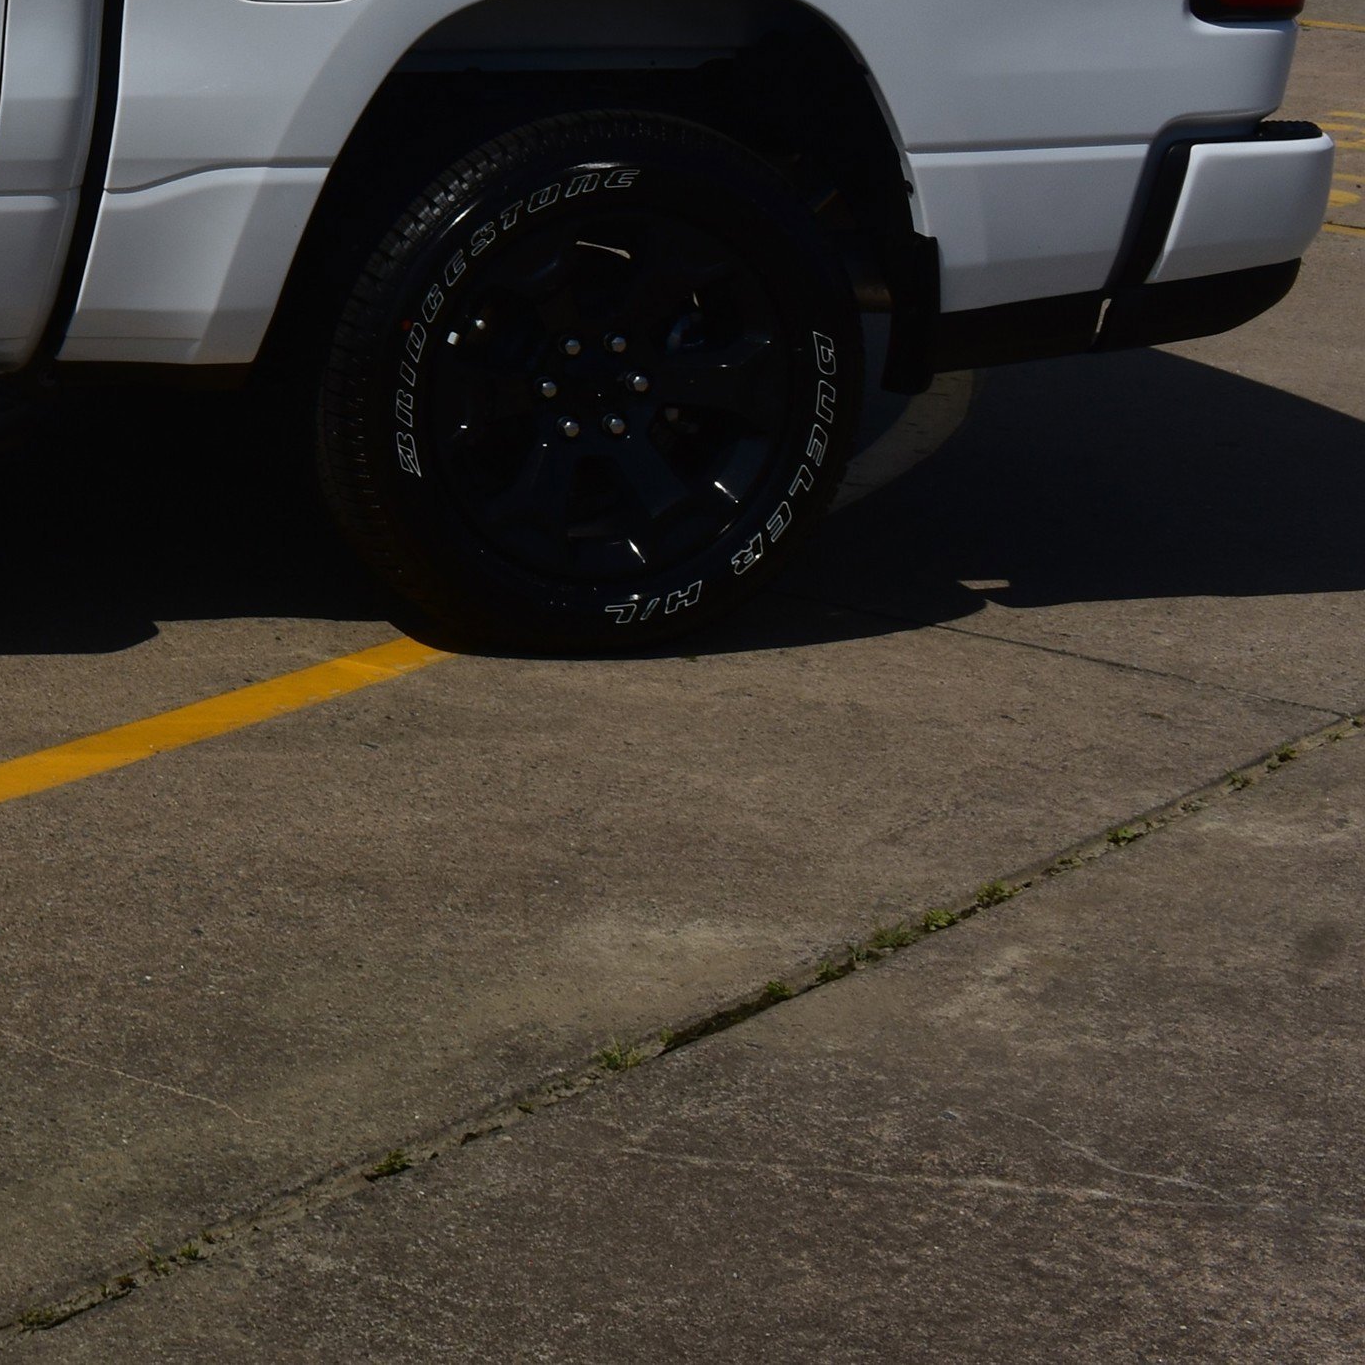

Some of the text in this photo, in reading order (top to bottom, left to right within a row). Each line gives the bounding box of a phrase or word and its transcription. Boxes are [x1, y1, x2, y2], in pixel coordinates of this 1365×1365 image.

[395, 169, 642, 478] BRIDGESTONE
[604, 330, 837, 625] DUELER H/L
